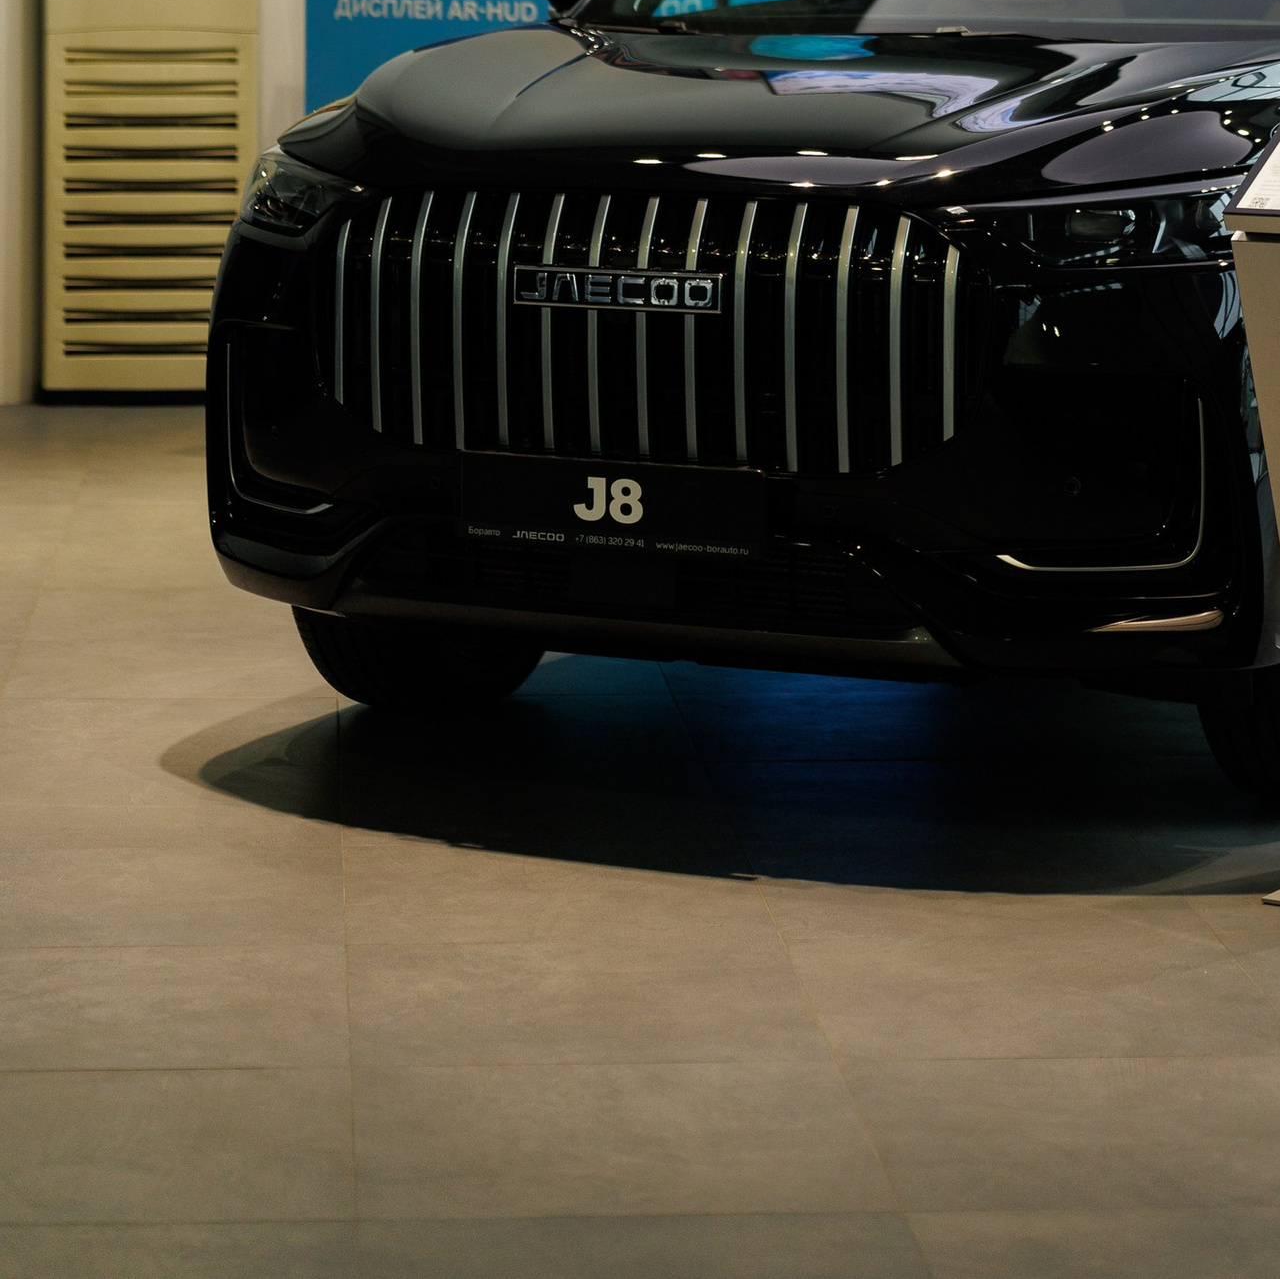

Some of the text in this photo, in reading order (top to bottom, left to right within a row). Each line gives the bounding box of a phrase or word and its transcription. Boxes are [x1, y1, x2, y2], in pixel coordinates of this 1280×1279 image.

[520, 273, 713, 307] JAECOO
[573, 476, 644, 524] J8
[468, 526, 501, 537] Боравто
[512, 530, 565, 542] JAECOO
[586, 535, 607, 546] (863)
[608, 536, 623, 546] 320
[624, 538, 635, 547] 29
[636, 539, 645, 548] 41
